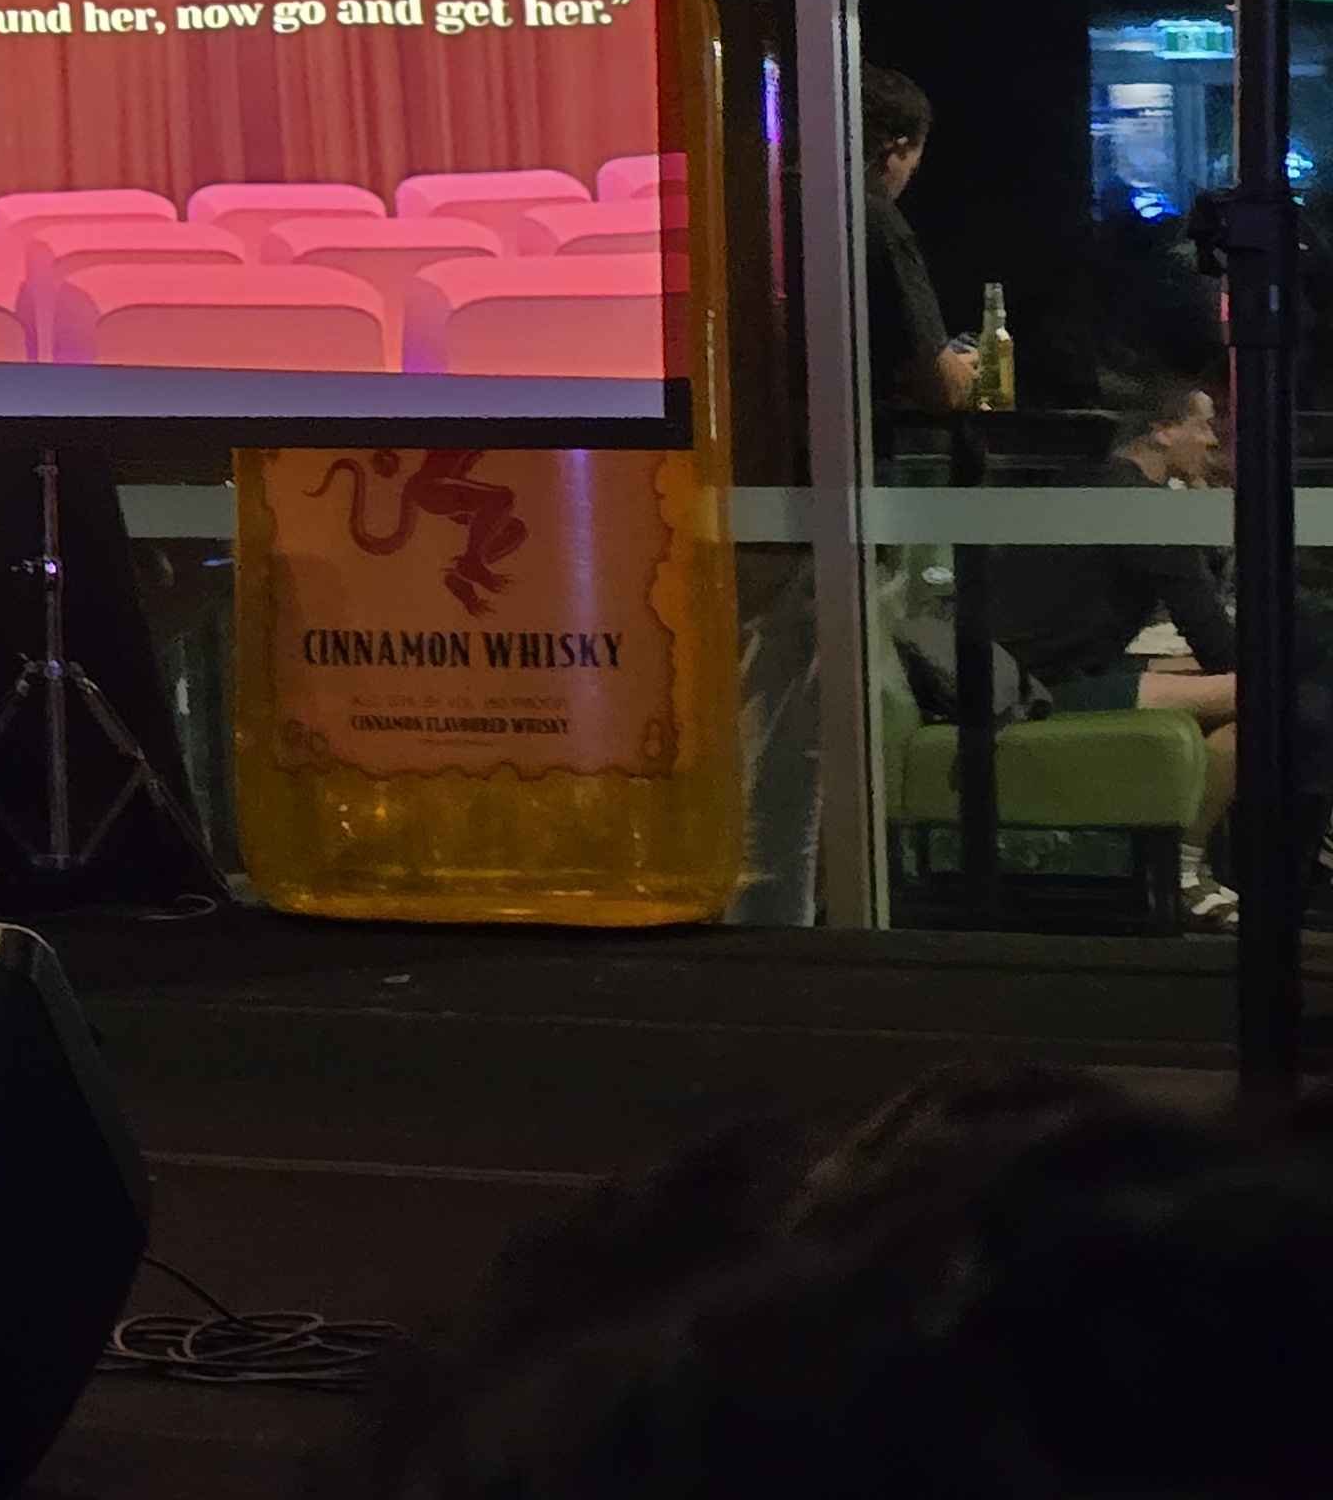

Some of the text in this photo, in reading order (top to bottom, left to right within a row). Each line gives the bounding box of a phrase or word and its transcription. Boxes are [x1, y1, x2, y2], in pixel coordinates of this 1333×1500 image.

[83, 1, 166, 35] her,
[176, 3, 264, 30] now
[273, 0, 326, 33] go
[302, 629, 623, 668] CINNAMON WHISKY
